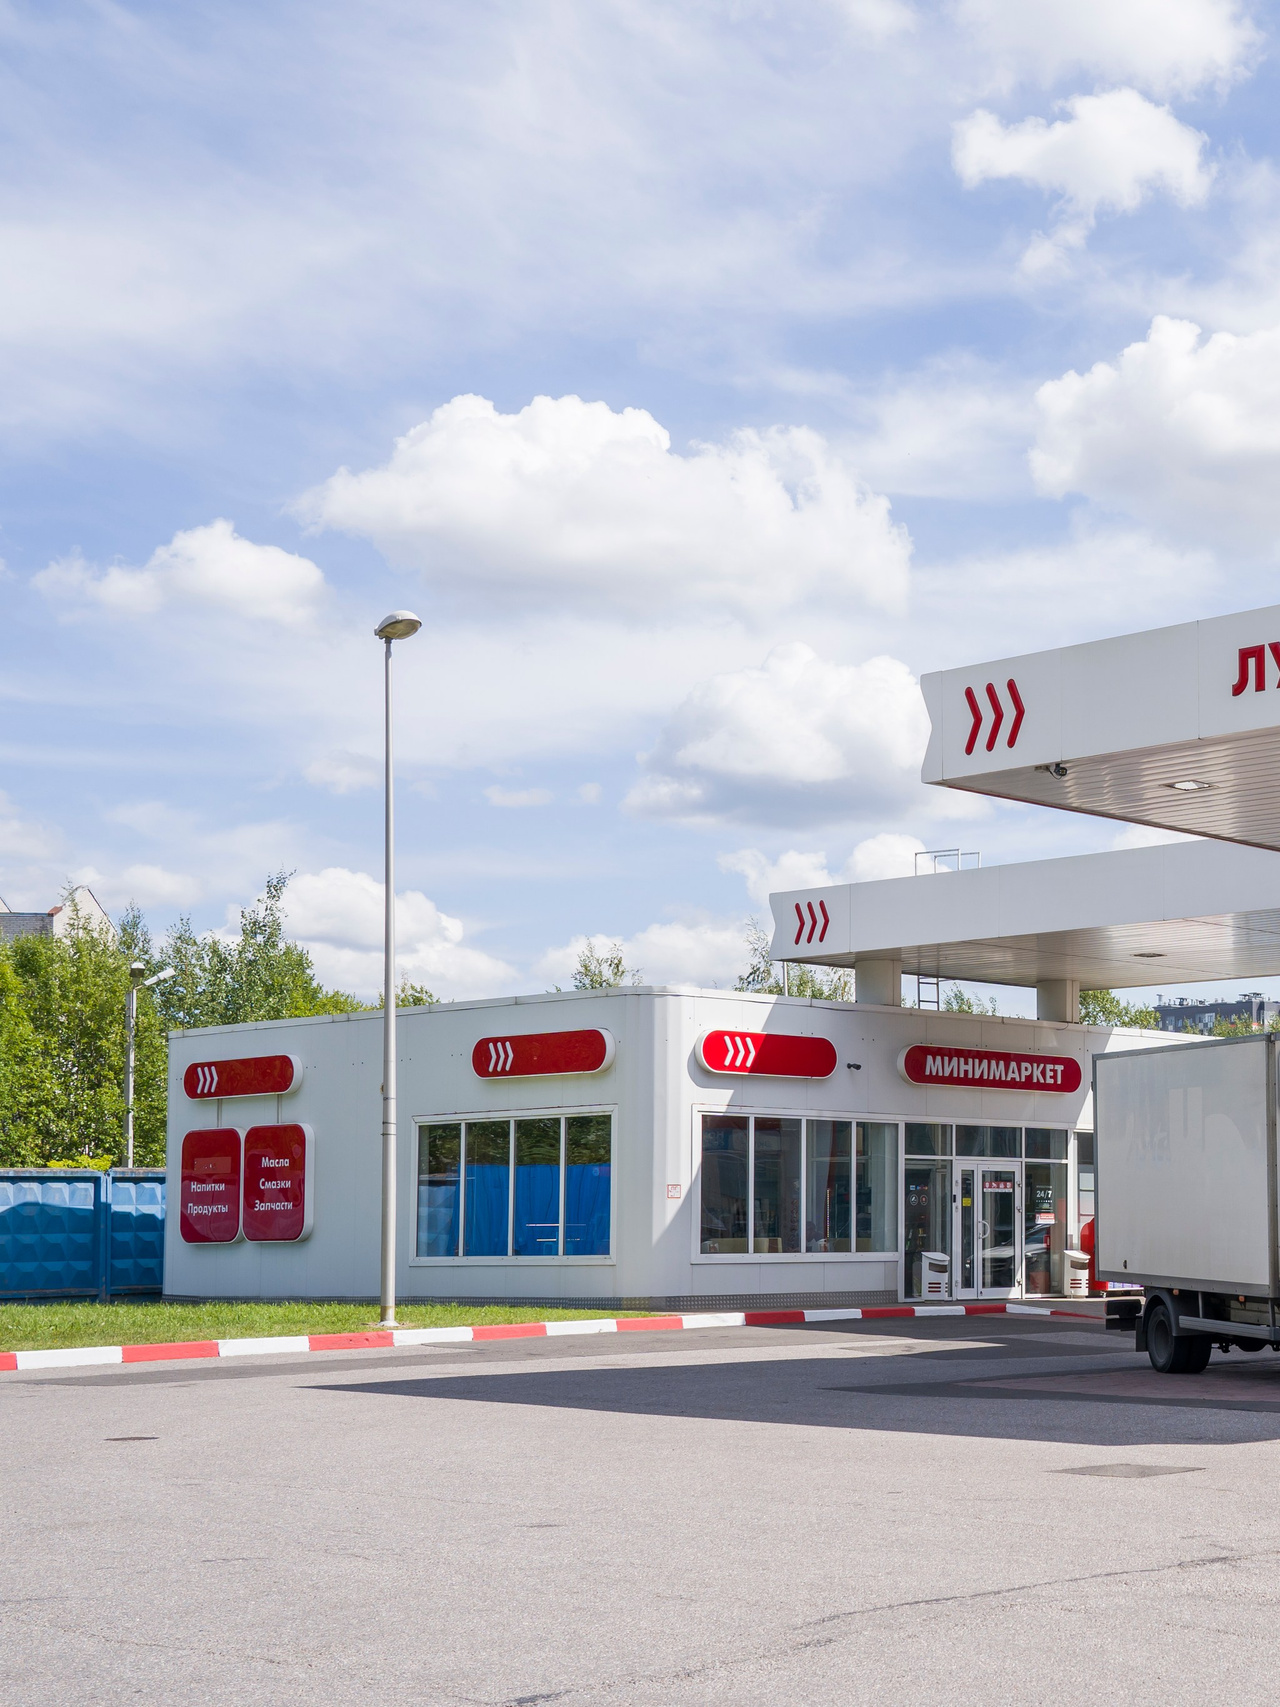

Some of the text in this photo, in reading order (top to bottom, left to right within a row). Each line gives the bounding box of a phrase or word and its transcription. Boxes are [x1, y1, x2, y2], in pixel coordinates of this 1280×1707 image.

[925, 1054, 1064, 1085] МИНИМАРКЕТ
[261, 1156, 290, 1168] Масла
[190, 1181, 225, 1192] Напитки
[259, 1178, 291, 1189] Смазки
[1036, 1190, 1053, 1198] 24/7
[187, 1203, 229, 1216] Продукты
[254, 1200, 293, 1211] Запчасти
